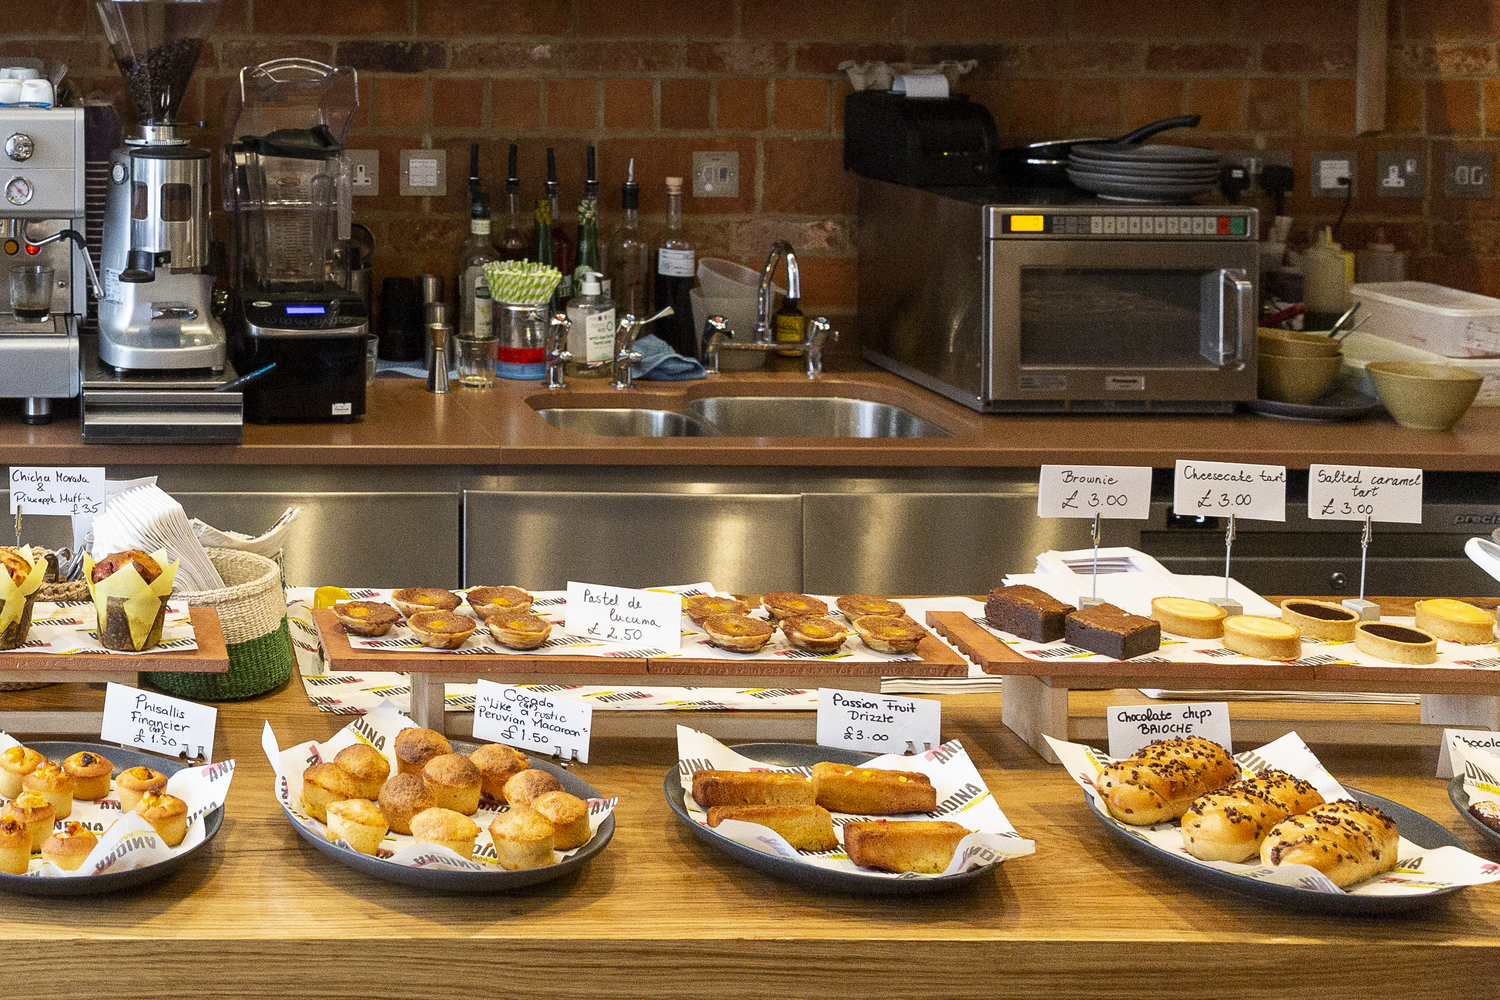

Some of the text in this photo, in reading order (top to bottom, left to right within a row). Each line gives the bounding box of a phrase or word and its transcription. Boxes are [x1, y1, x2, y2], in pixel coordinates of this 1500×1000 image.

[11, 469, 90, 484] Chicha Morada
[1061, 470, 1119, 485] Brownie
[1184, 465, 1286, 483] Cheesecake tart
[1317, 470, 1421, 486] Salted caramel
[37, 482, 45, 492] &
[1352, 485, 1380, 497] tart
[583, 588, 642, 609] Pastel de
[609, 608, 661, 628] lucuma
[367, 638, 421, 648] ANDINA
[135, 694, 185, 719] Phisallis
[504, 689, 554, 708] Cocada
[833, 693, 916, 713] Passion Fruit
[131, 711, 190, 732] Financier
[478, 706, 525, 725] Peruvian
[521, 708, 567, 723] a rustic
[848, 711, 894, 723] Drizzle
[1118, 706, 1212, 724] Chocolate chips
[926, 783, 982, 818] ANDINA
